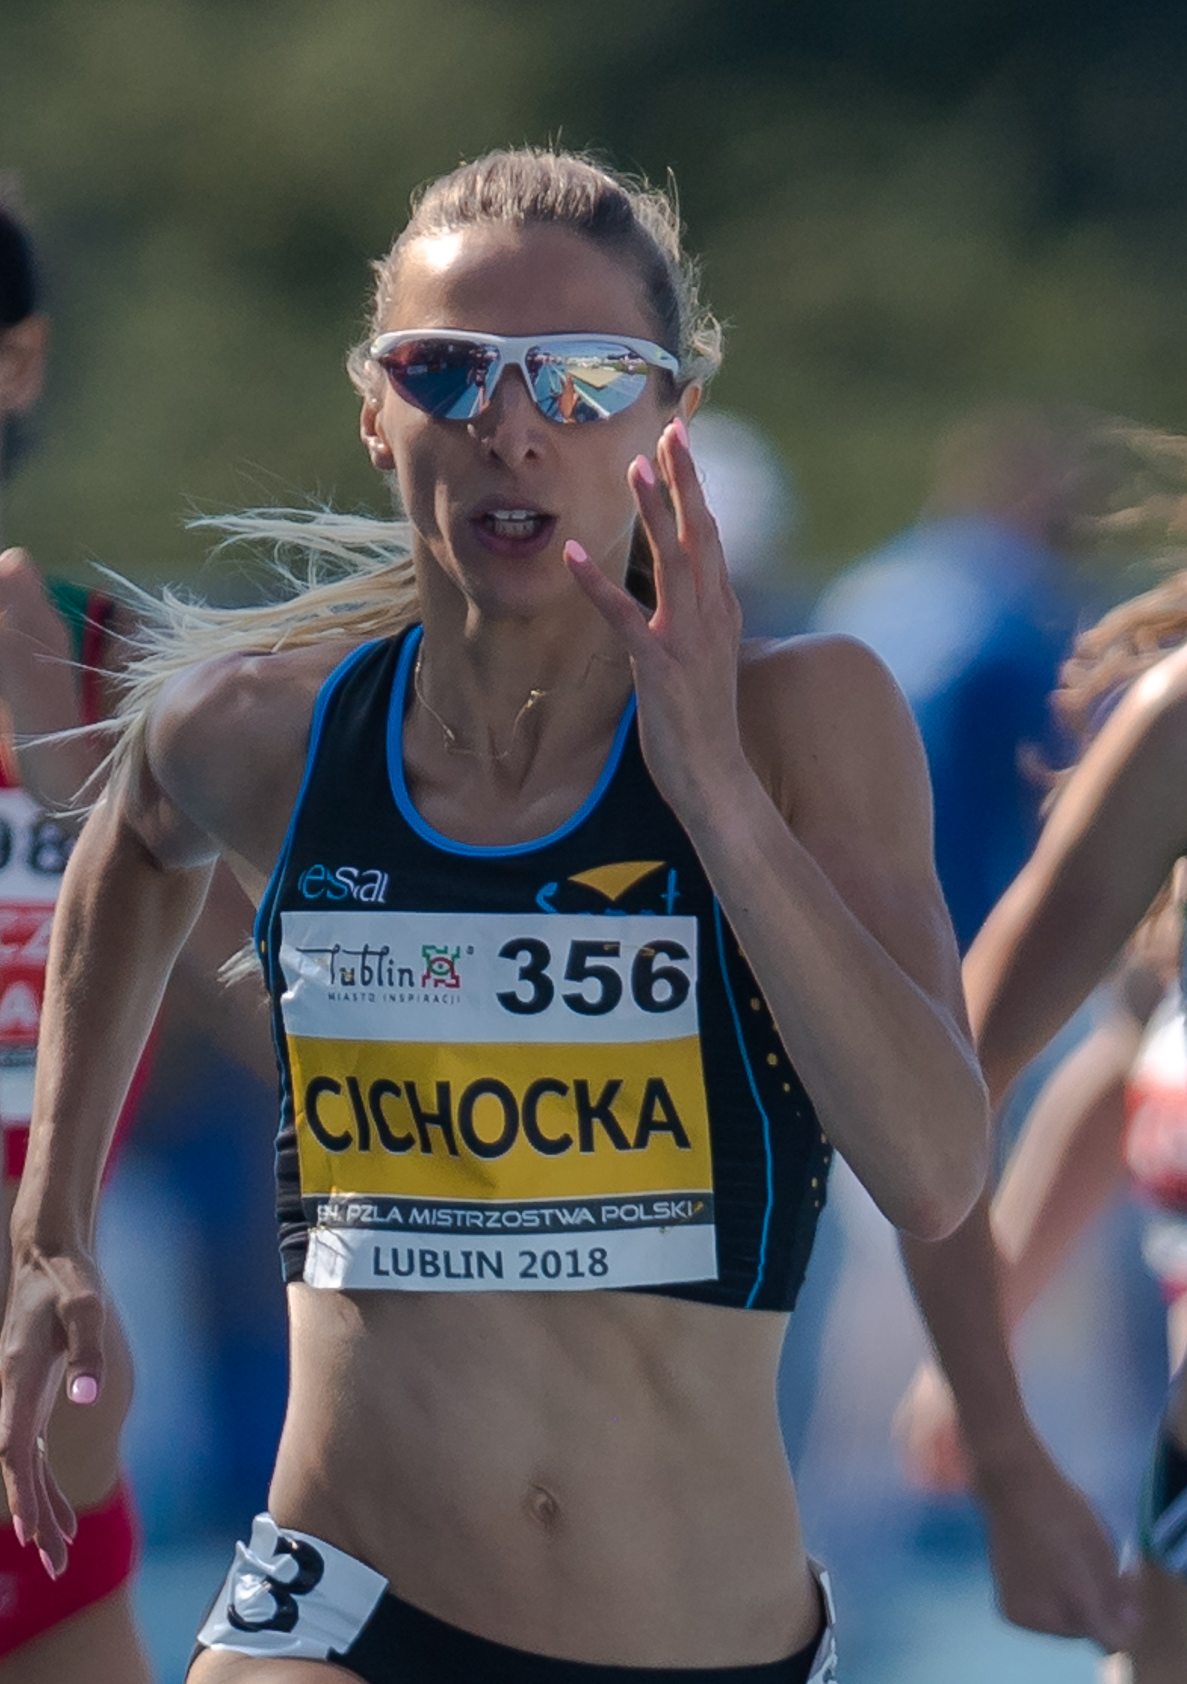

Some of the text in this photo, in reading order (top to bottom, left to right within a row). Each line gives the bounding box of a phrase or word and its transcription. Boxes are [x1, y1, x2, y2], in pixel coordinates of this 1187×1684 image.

[496, 937, 691, 1016] 356
[328, 992, 461, 1005] MIASTO INSPIRACJI
[304, 1075, 692, 1160] CICHOCKA
[346, 1204, 403, 1224] PZLA
[408, 1206, 597, 1229] MISTRZOSTWA
[601, 1200, 694, 1224] POLSKI
[373, 1246, 609, 1280] LUBLIN 2018
